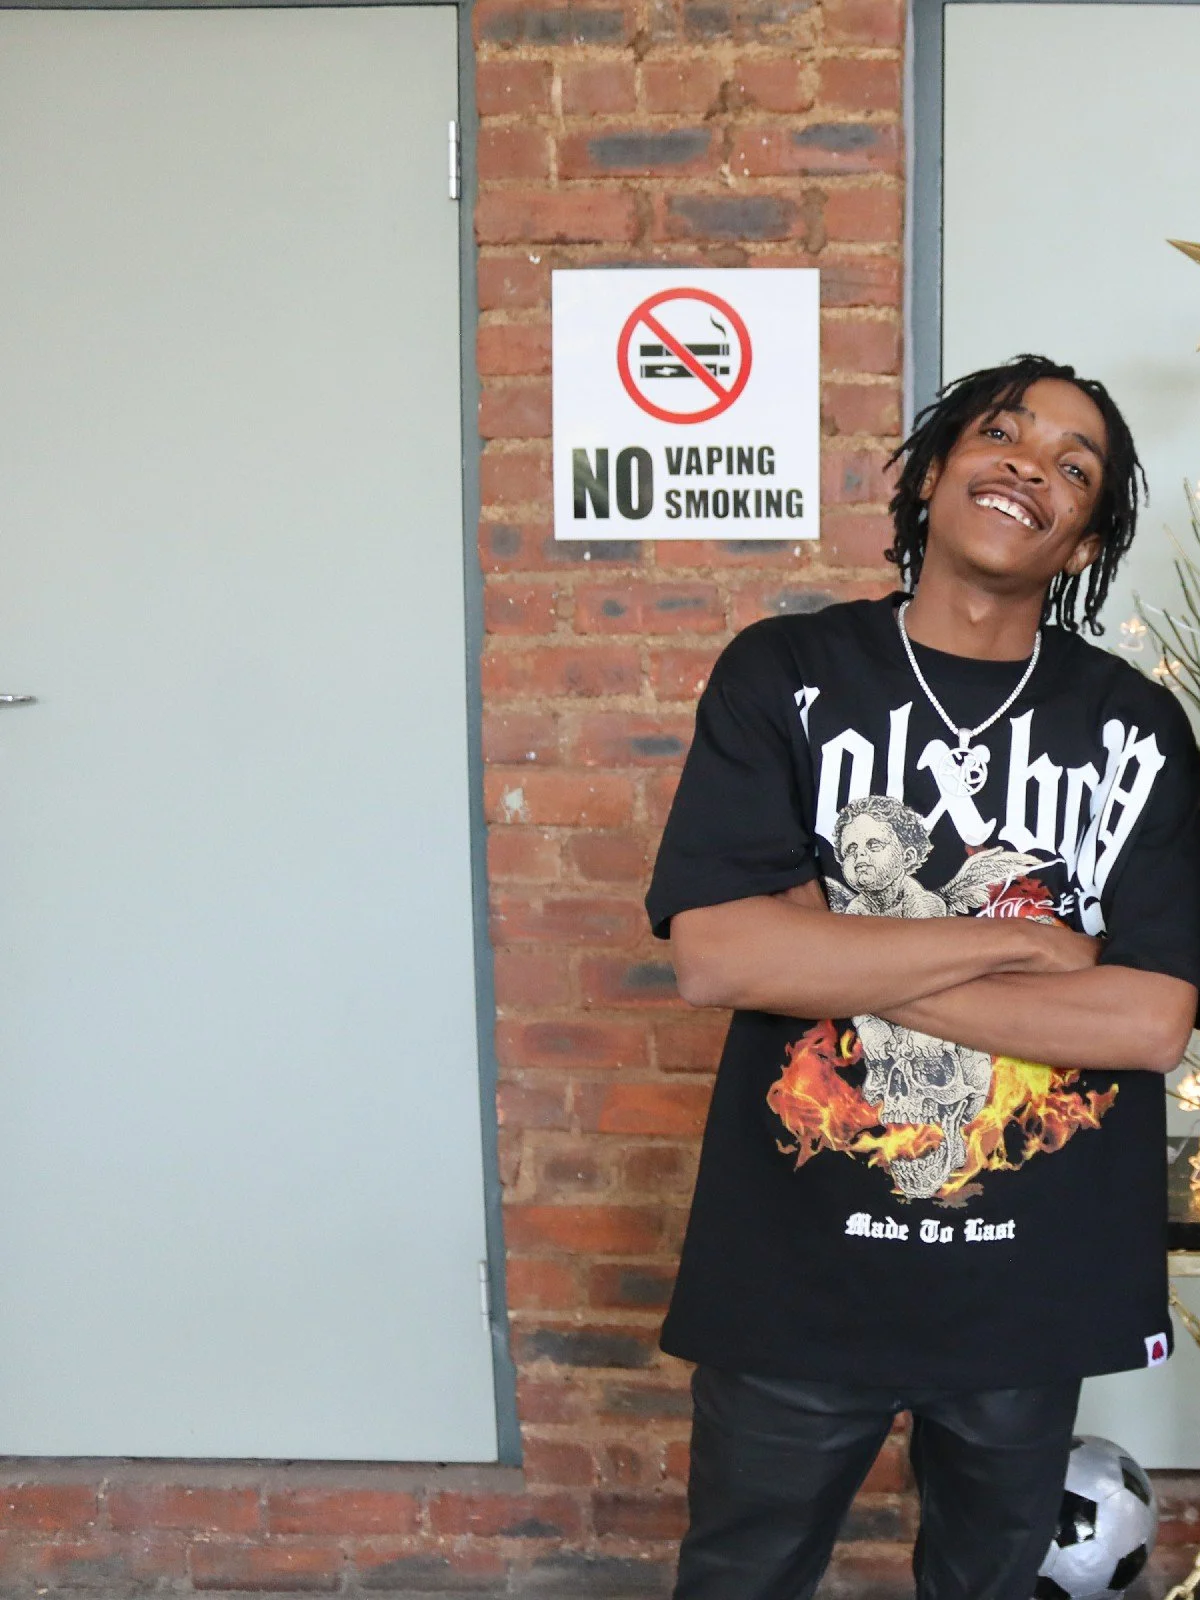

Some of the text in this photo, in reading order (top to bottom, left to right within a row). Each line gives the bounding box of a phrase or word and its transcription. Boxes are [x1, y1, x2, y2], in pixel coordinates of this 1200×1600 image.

[664, 445, 776, 476] VAPING
[572, 445, 654, 520] NO
[664, 488, 805, 519] SMOKING
[845, 1212, 1016, 1243] Made To Last
